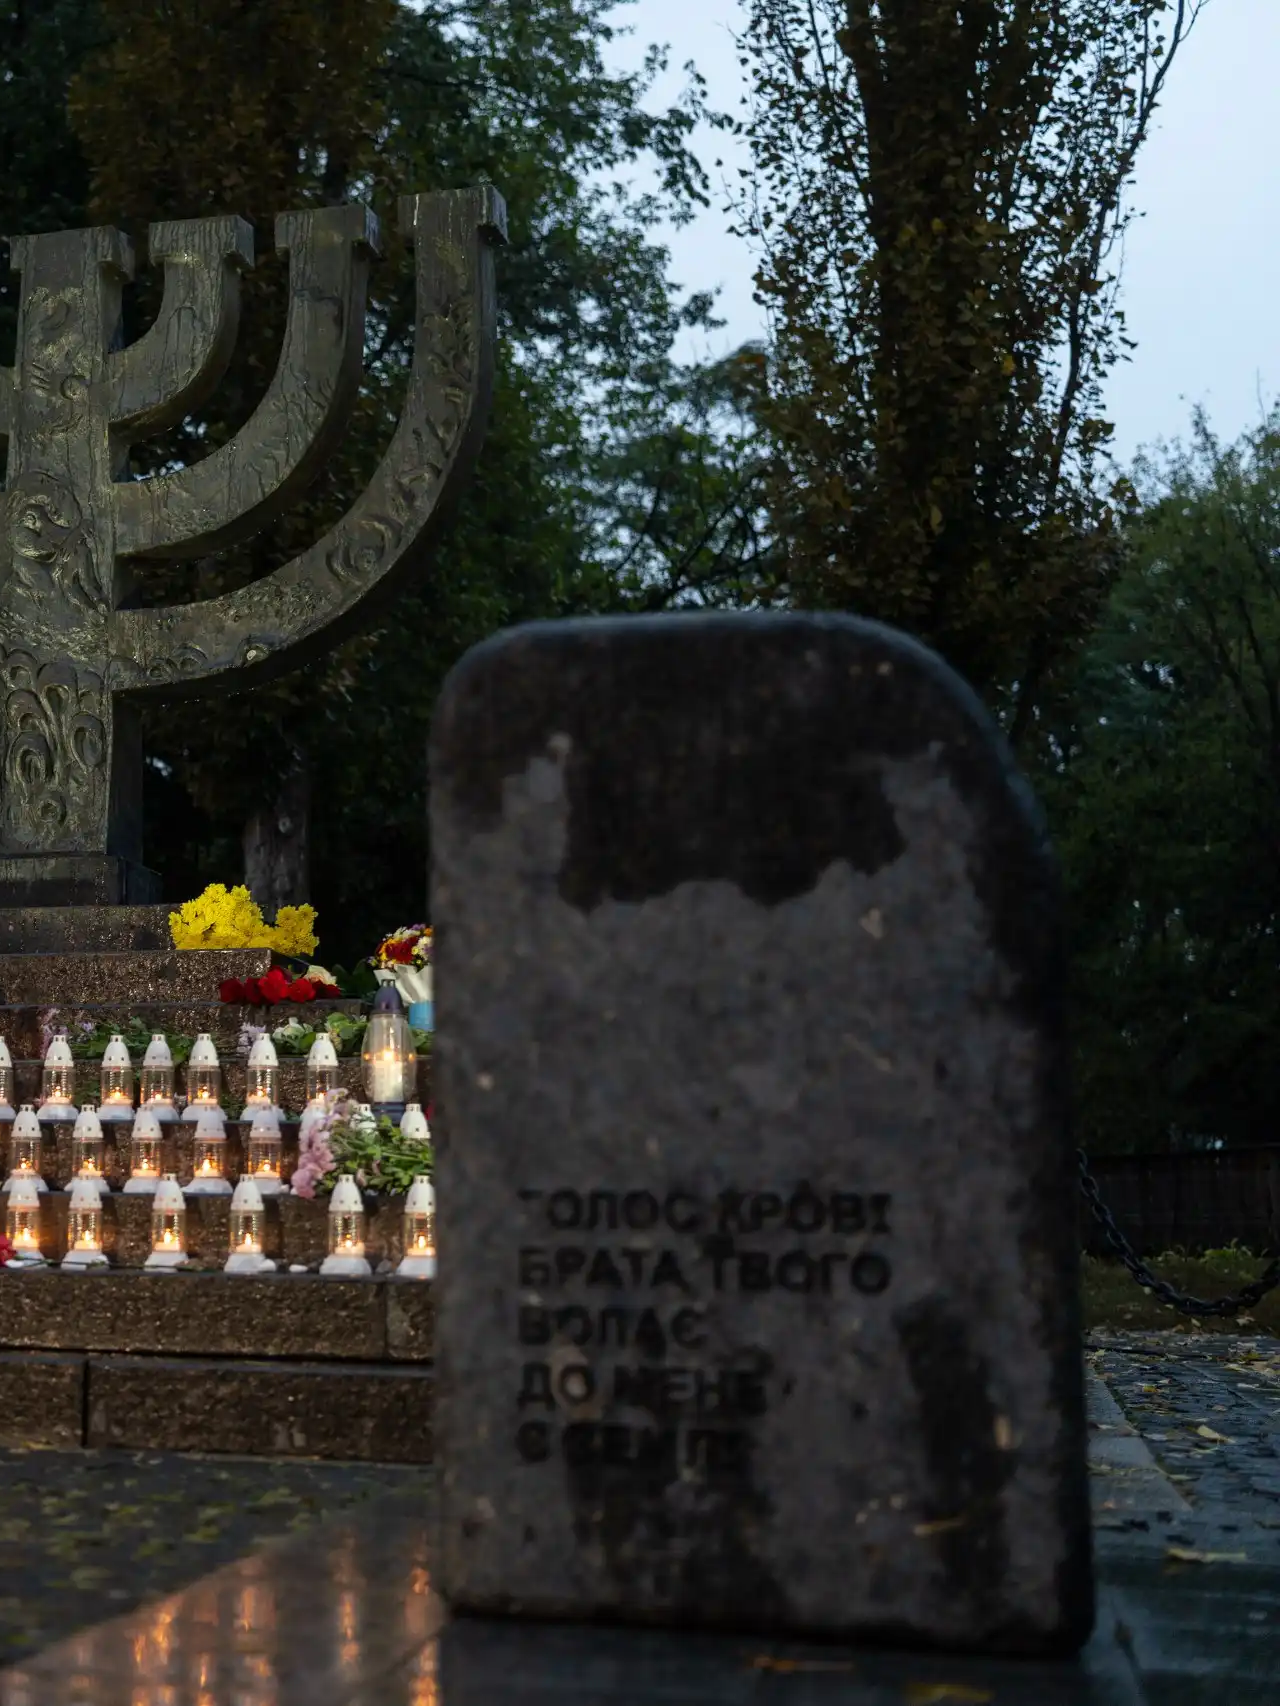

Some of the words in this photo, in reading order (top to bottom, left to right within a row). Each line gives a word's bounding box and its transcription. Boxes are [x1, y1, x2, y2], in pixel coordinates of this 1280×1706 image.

[519, 1247, 687, 1290] БРАТА
[709, 1249, 892, 1295] ТВОГО
[518, 1365, 595, 1409] ДО
